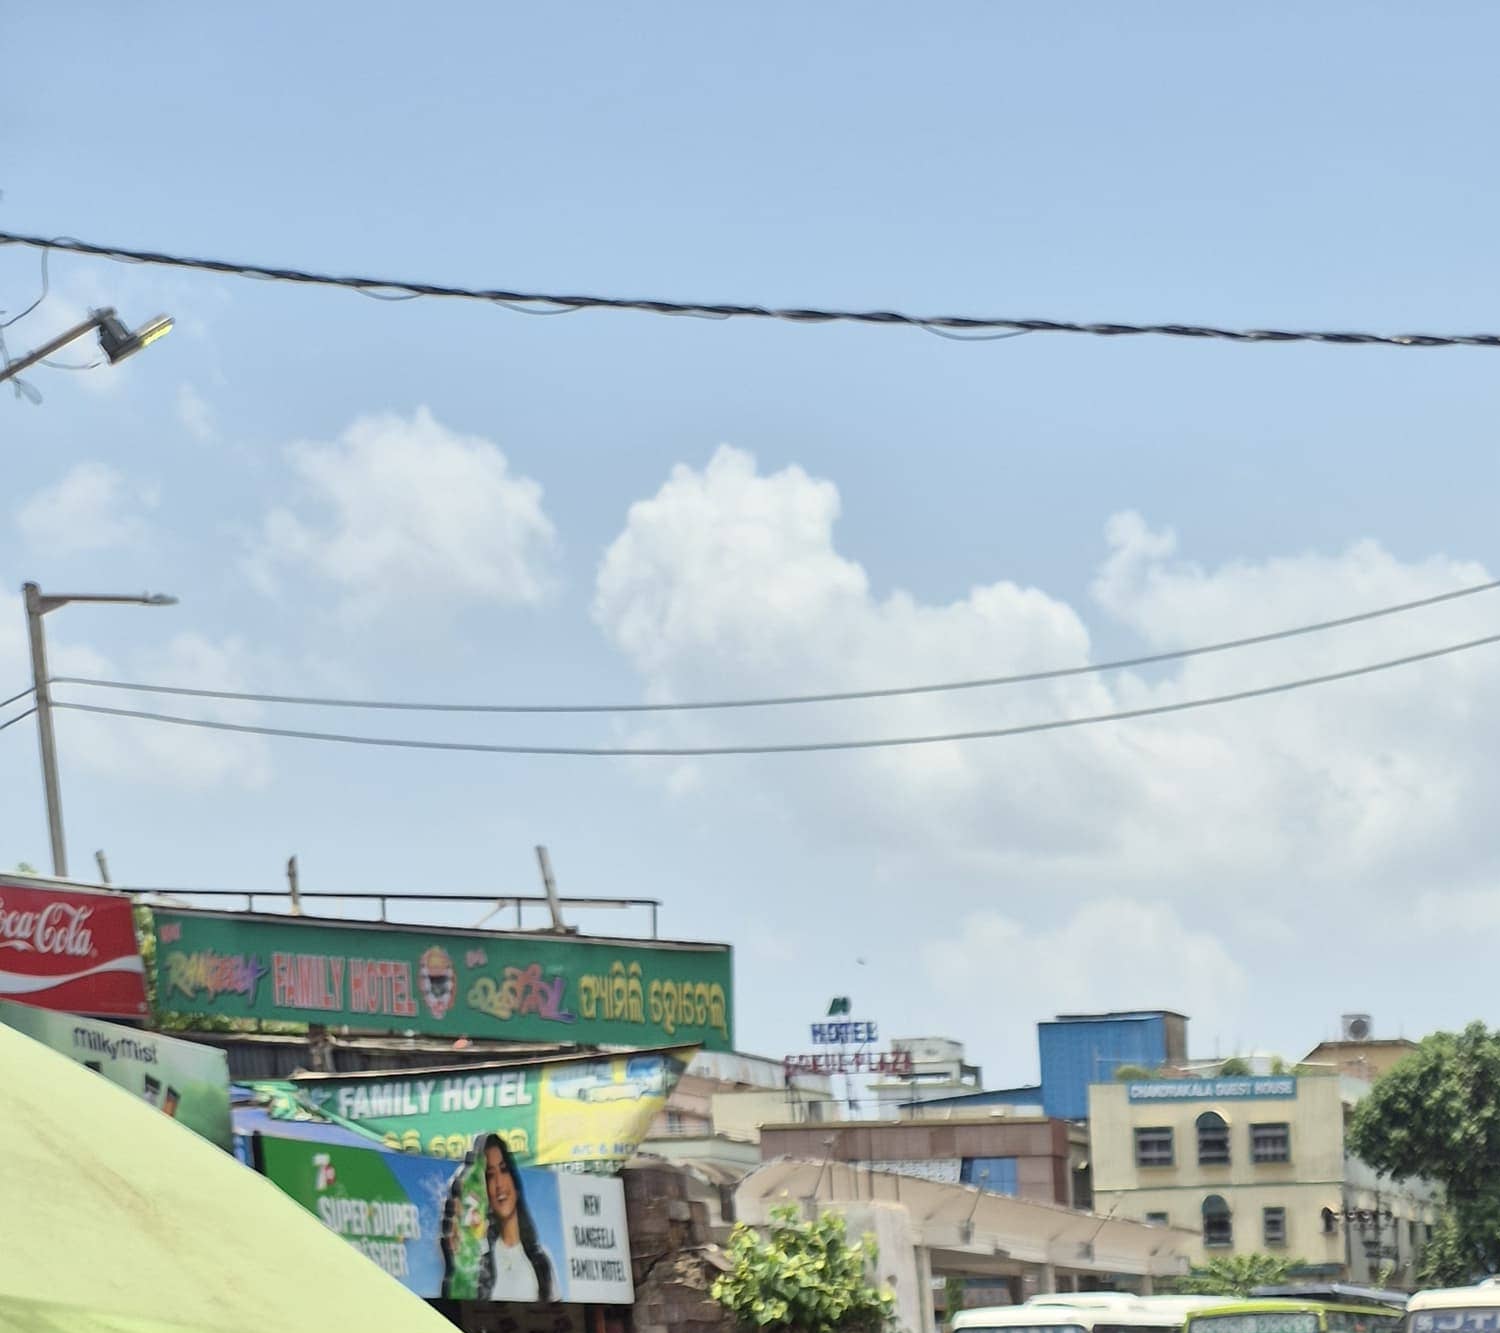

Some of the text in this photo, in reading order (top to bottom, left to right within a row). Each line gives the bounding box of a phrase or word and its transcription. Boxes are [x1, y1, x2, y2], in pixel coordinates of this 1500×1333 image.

[0, 902, 93, 957] oca-Cola
[272, 952, 346, 1012] FAMILY
[349, 956, 418, 1018] HOTEL
[811, 1021, 878, 1044] HOTEL
[338, 1072, 533, 1121] FAMILY HOTEL
[1215, 1080, 1250, 1096] GUEST
[1254, 1078, 1293, 1095] HOUSE
[317, 1196, 372, 1236] SUPER
[373, 1201, 422, 1241] DUPER
